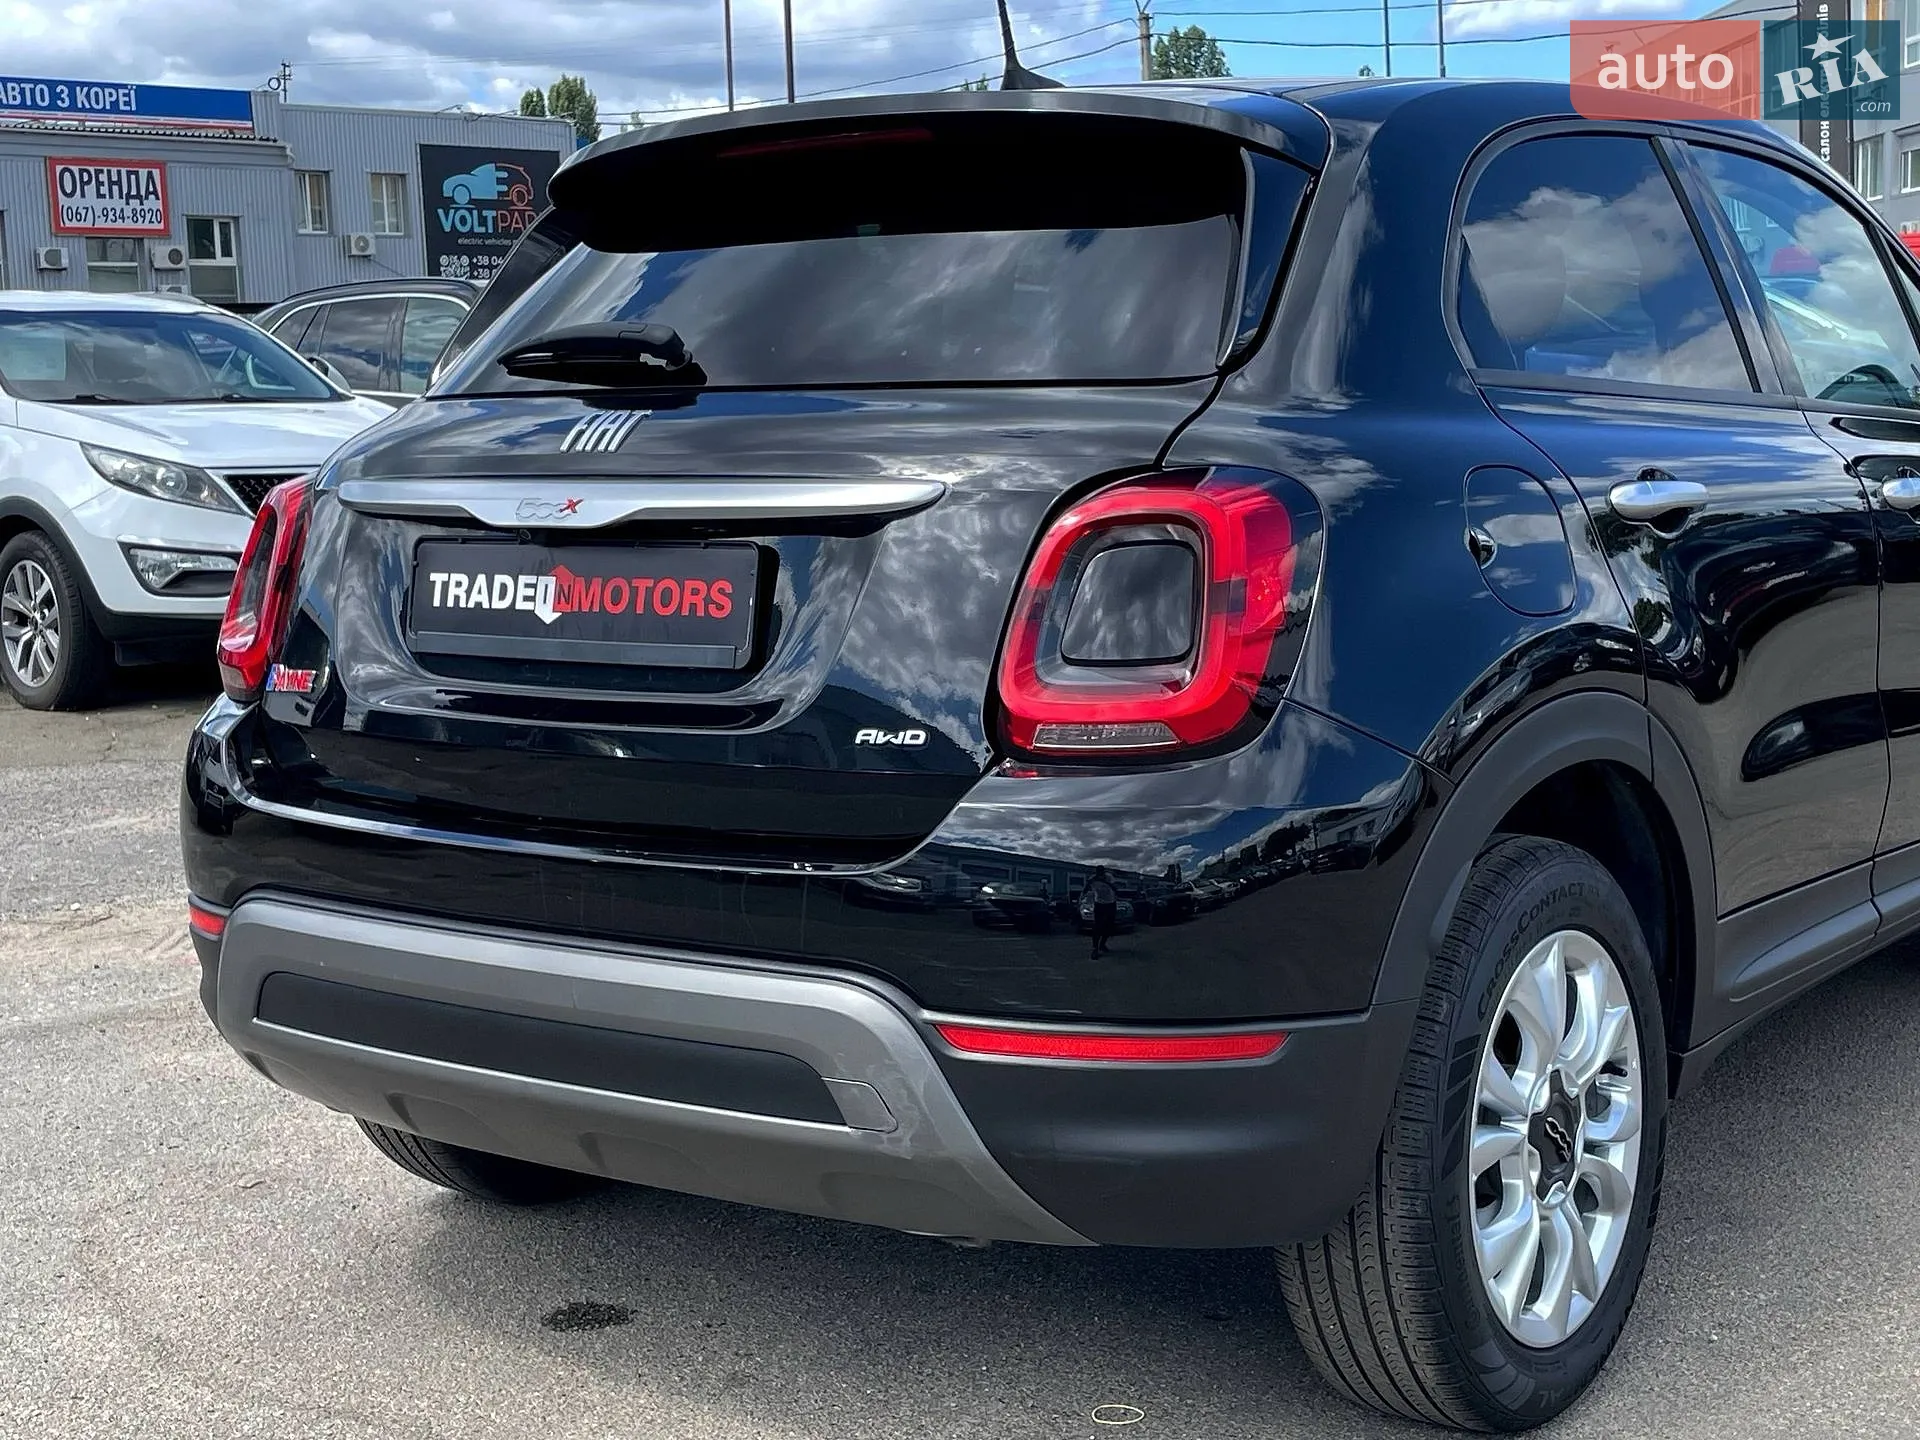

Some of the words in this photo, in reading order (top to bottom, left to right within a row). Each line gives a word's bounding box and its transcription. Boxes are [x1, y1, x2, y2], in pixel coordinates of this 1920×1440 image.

[1817, 3, 1830, 119] електрмобілів
[76, 85, 137, 111] КОРЕЇ
[1819, 121, 1831, 162] салон
[58, 166, 161, 205] ОРЕНДА
[60, 204, 163, 226] (067)-934-8920
[559, 410, 653, 453] FIAT
[854, 729, 927, 746] AWD
